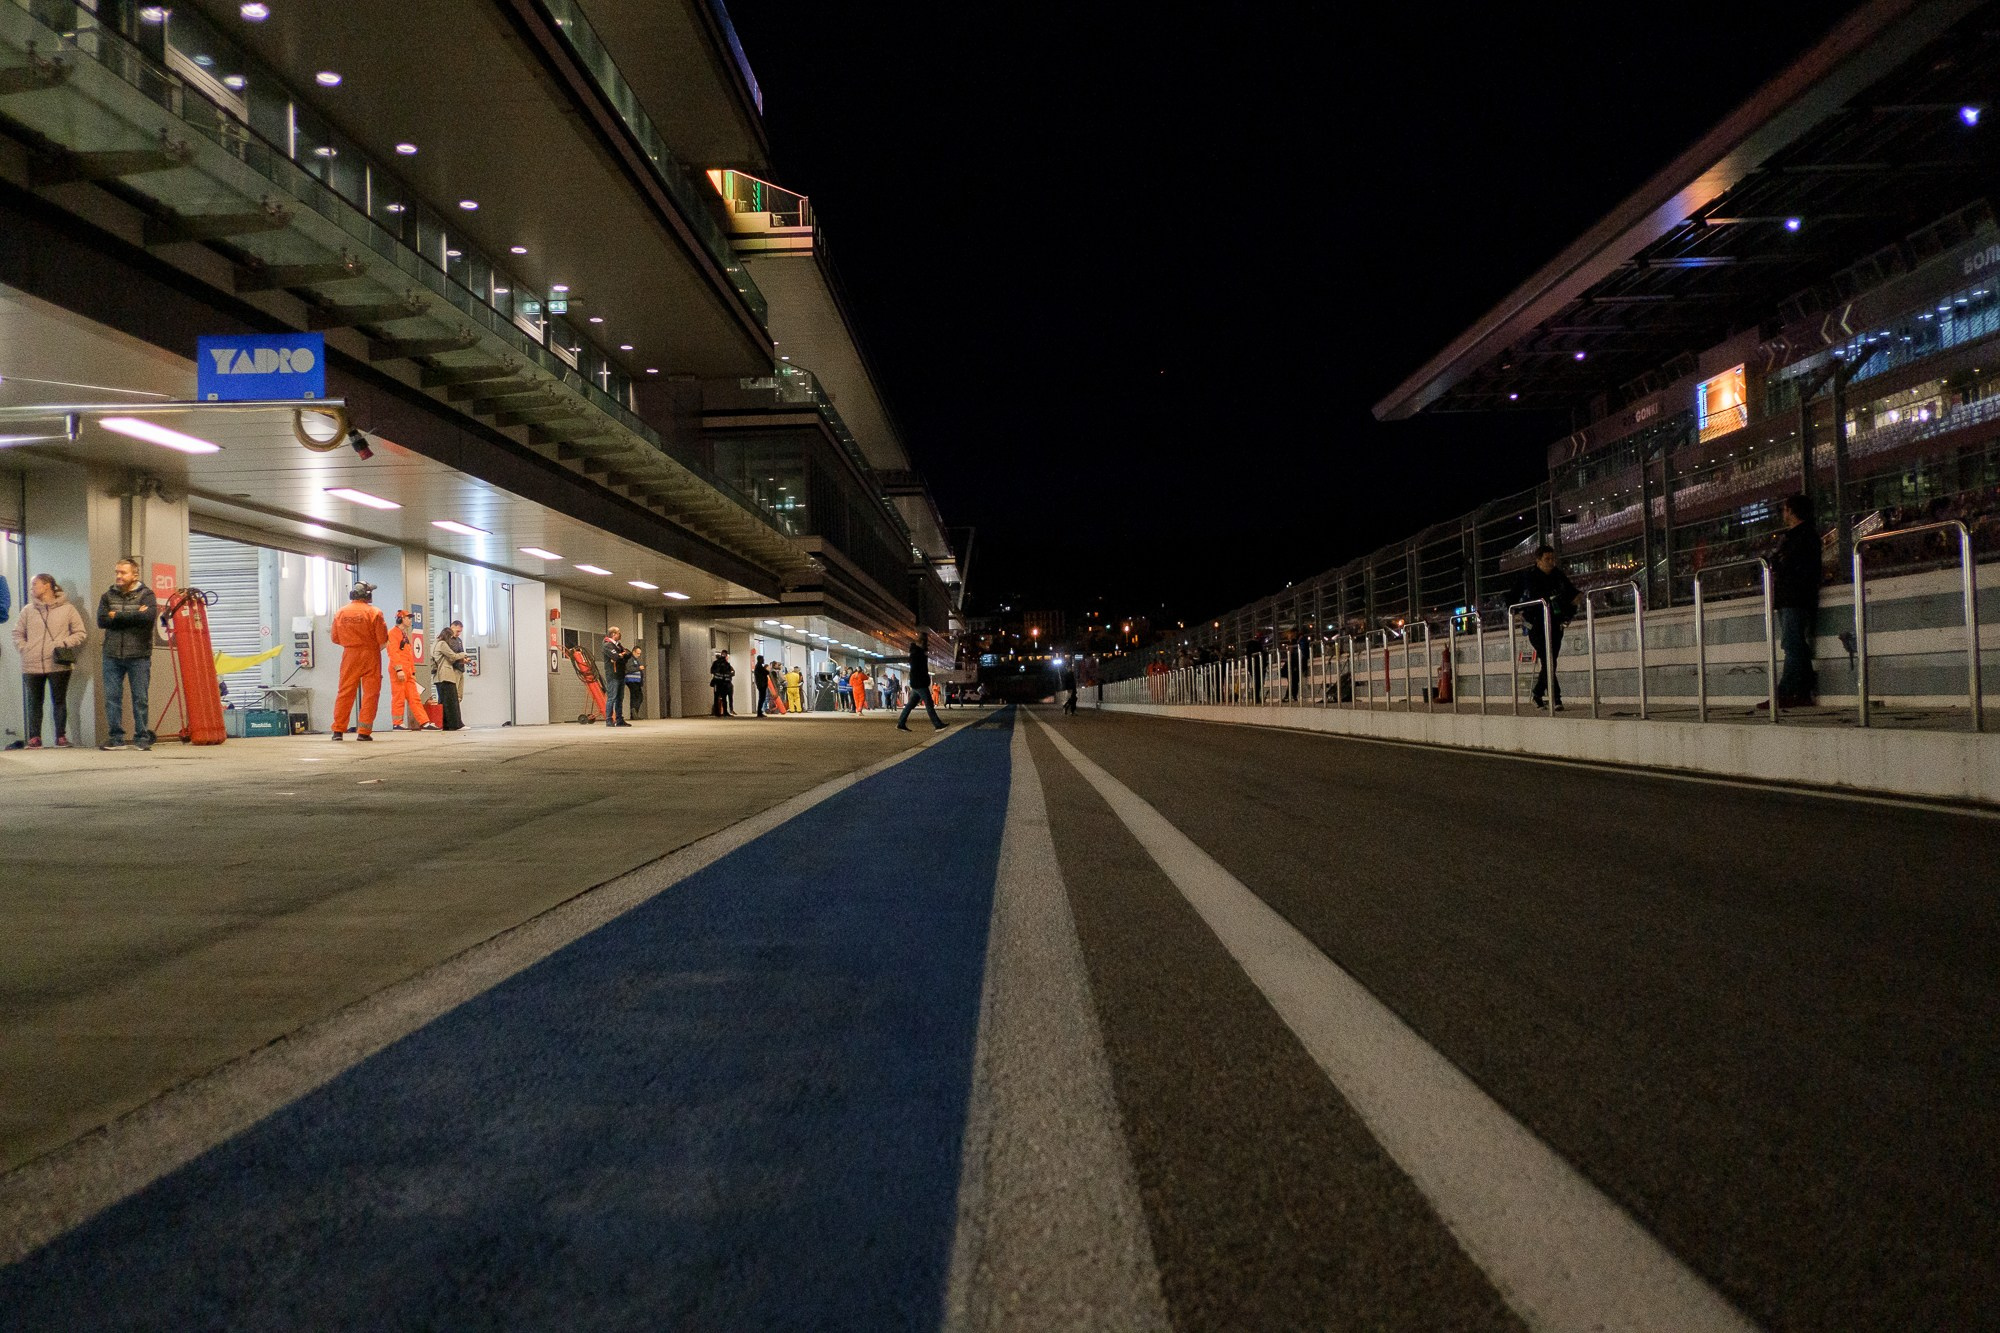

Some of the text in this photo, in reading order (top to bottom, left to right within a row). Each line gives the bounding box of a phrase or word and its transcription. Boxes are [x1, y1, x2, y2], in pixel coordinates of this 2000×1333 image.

[209, 348, 315, 374] YADRO
[156, 575, 173, 589] 20
[413, 612, 422, 623] 19
